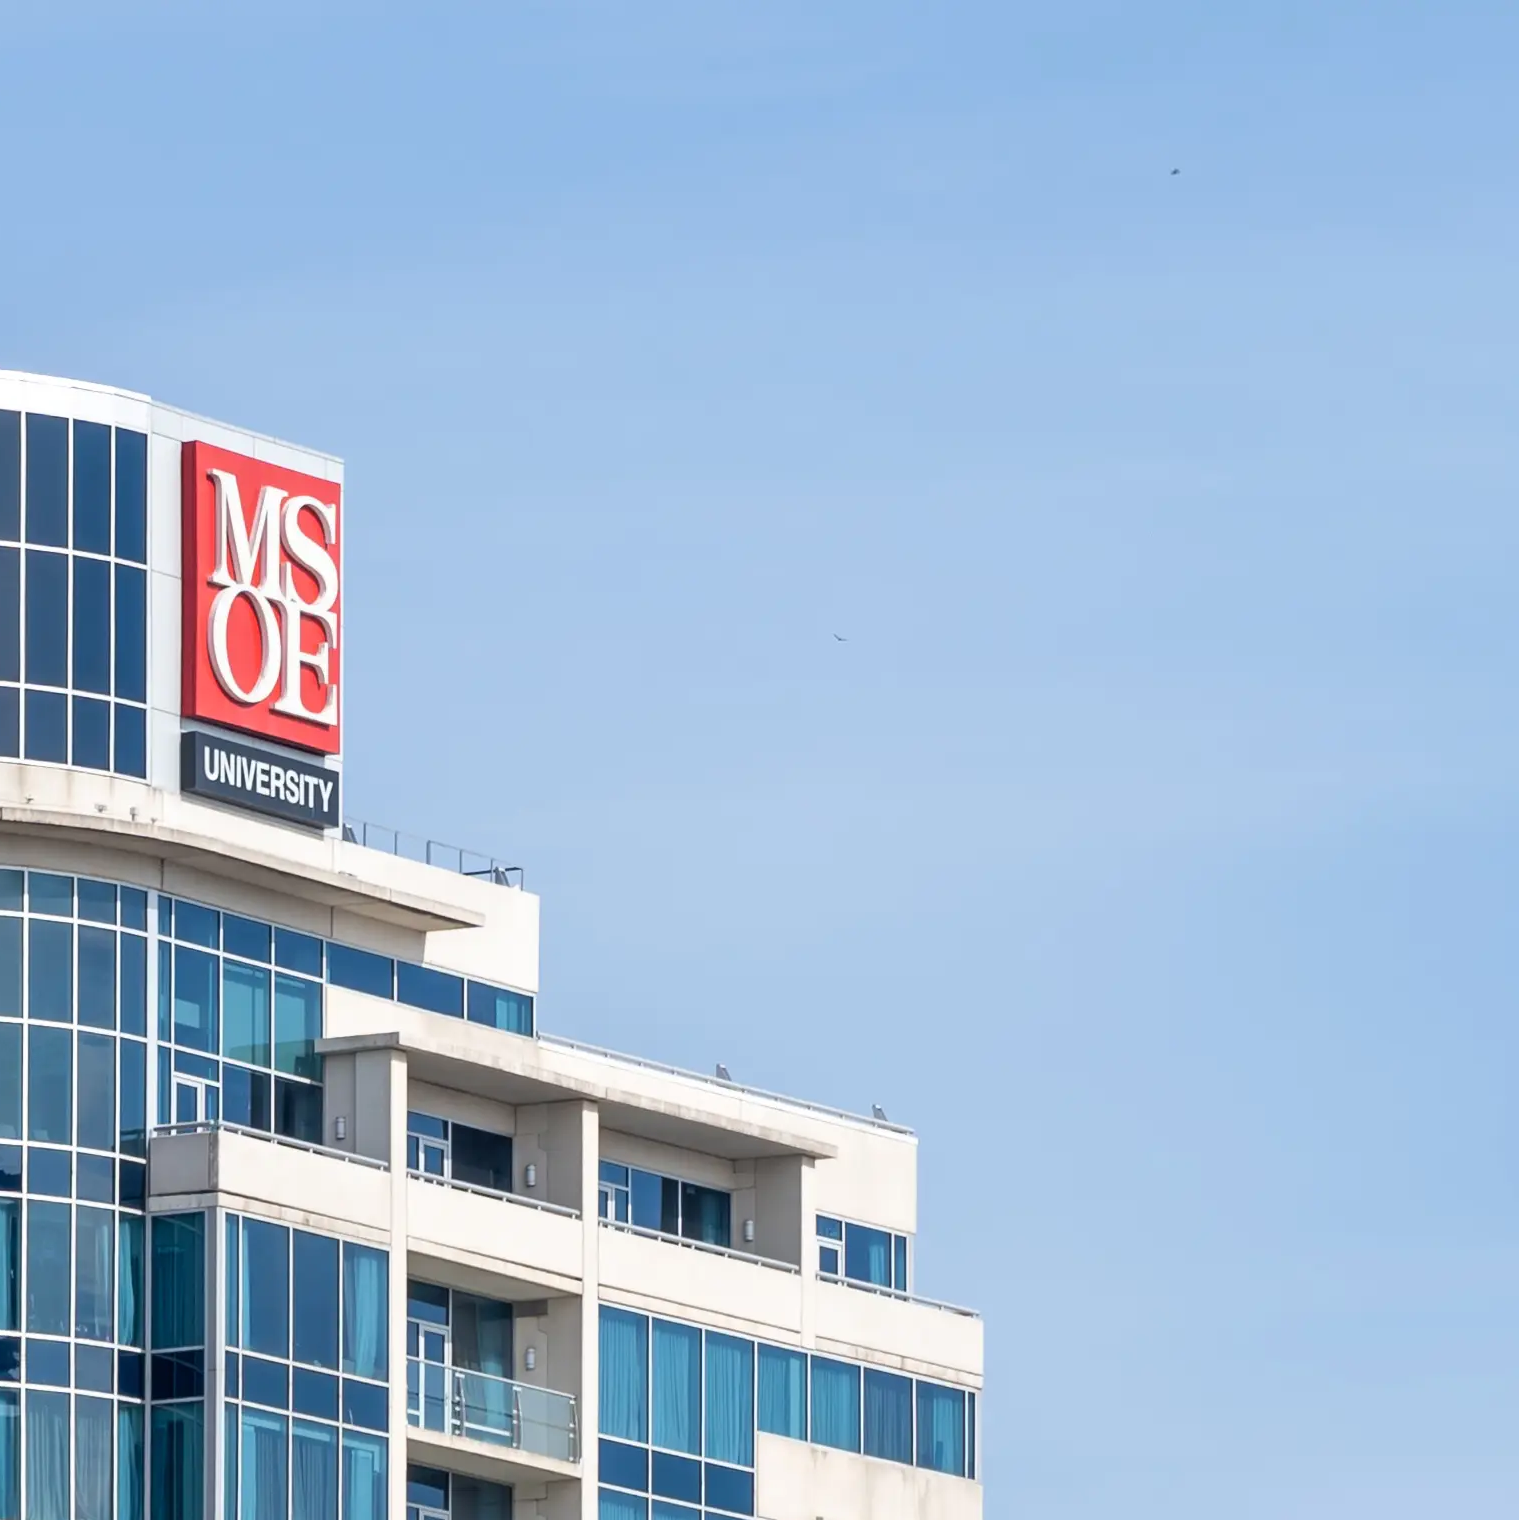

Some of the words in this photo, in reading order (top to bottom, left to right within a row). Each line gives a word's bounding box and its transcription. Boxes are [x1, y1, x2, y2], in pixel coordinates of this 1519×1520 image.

[206, 468, 340, 611] MS
[206, 583, 338, 727] OE
[204, 745, 334, 813] UNIVERSITY
